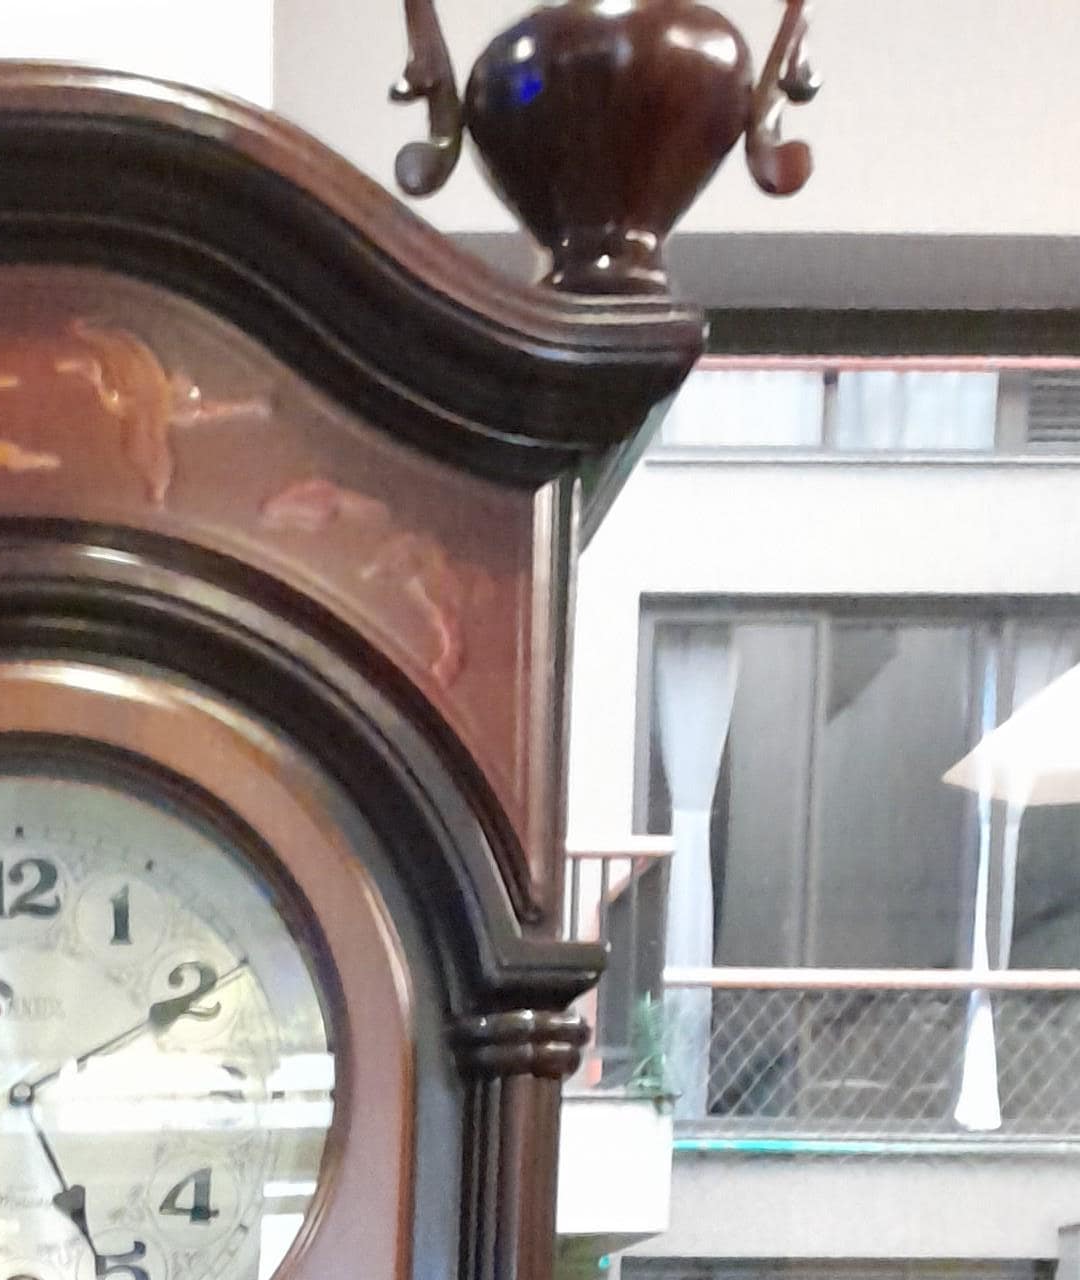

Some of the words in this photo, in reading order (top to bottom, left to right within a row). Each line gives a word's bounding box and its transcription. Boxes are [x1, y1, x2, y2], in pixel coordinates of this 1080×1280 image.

[109, 885, 132, 945] 1
[166, 961, 222, 1021] 2
[159, 1167, 220, 1224] 4
